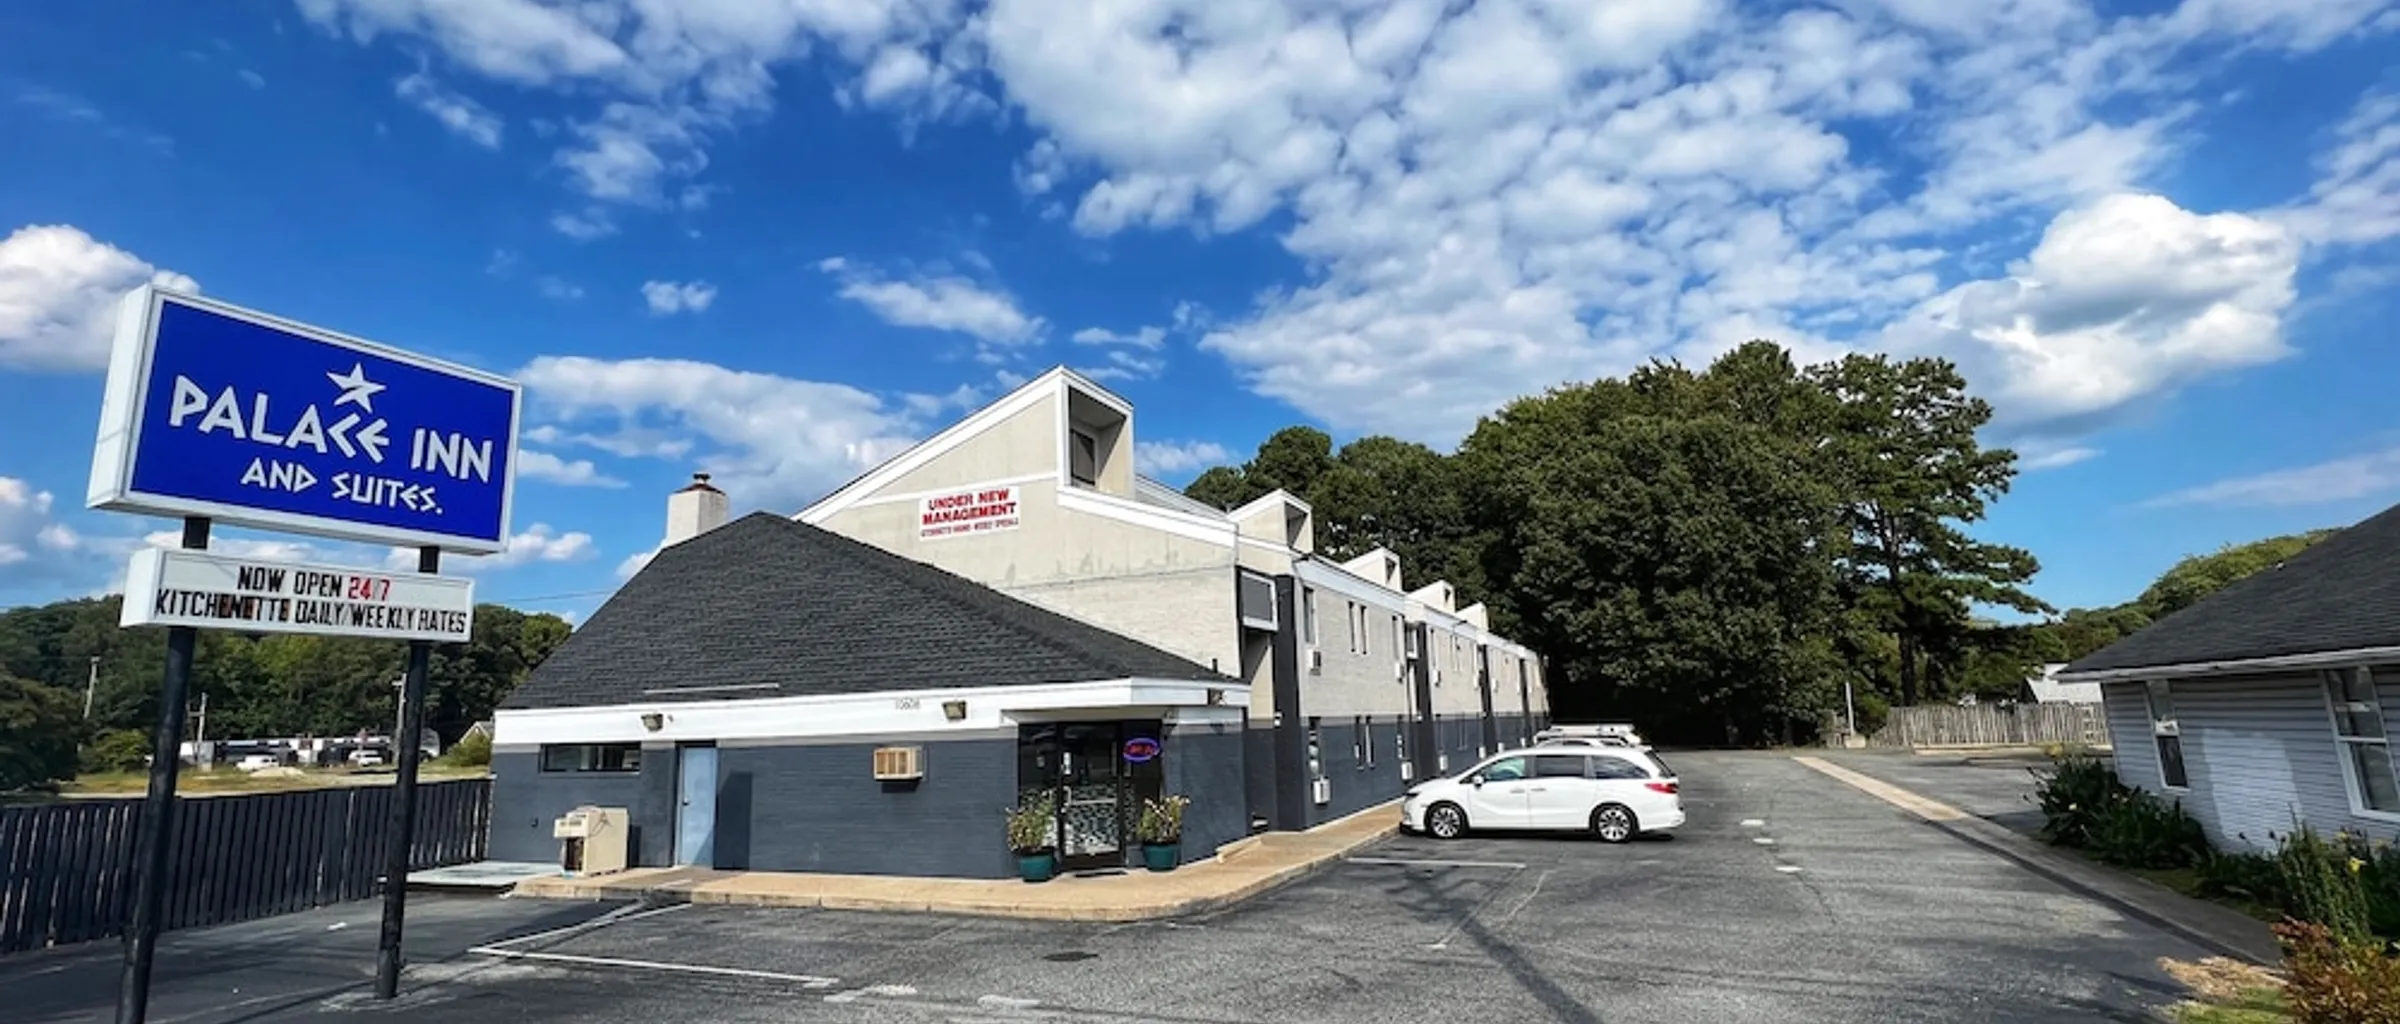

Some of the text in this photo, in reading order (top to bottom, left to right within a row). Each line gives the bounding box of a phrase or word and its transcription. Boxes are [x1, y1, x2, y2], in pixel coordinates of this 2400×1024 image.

[169, 375, 492, 482] PALACE INN
[240, 458, 317, 492] AND
[923, 502, 1016, 524] MANAGEMENT
[928, 488, 1009, 510] UNDER NEW
[237, 566, 286, 592] NOW
[294, 572, 342, 597] OPEN
[155, 589, 291, 622] KITCHENETTE
[417, 608, 467, 633] RATES
